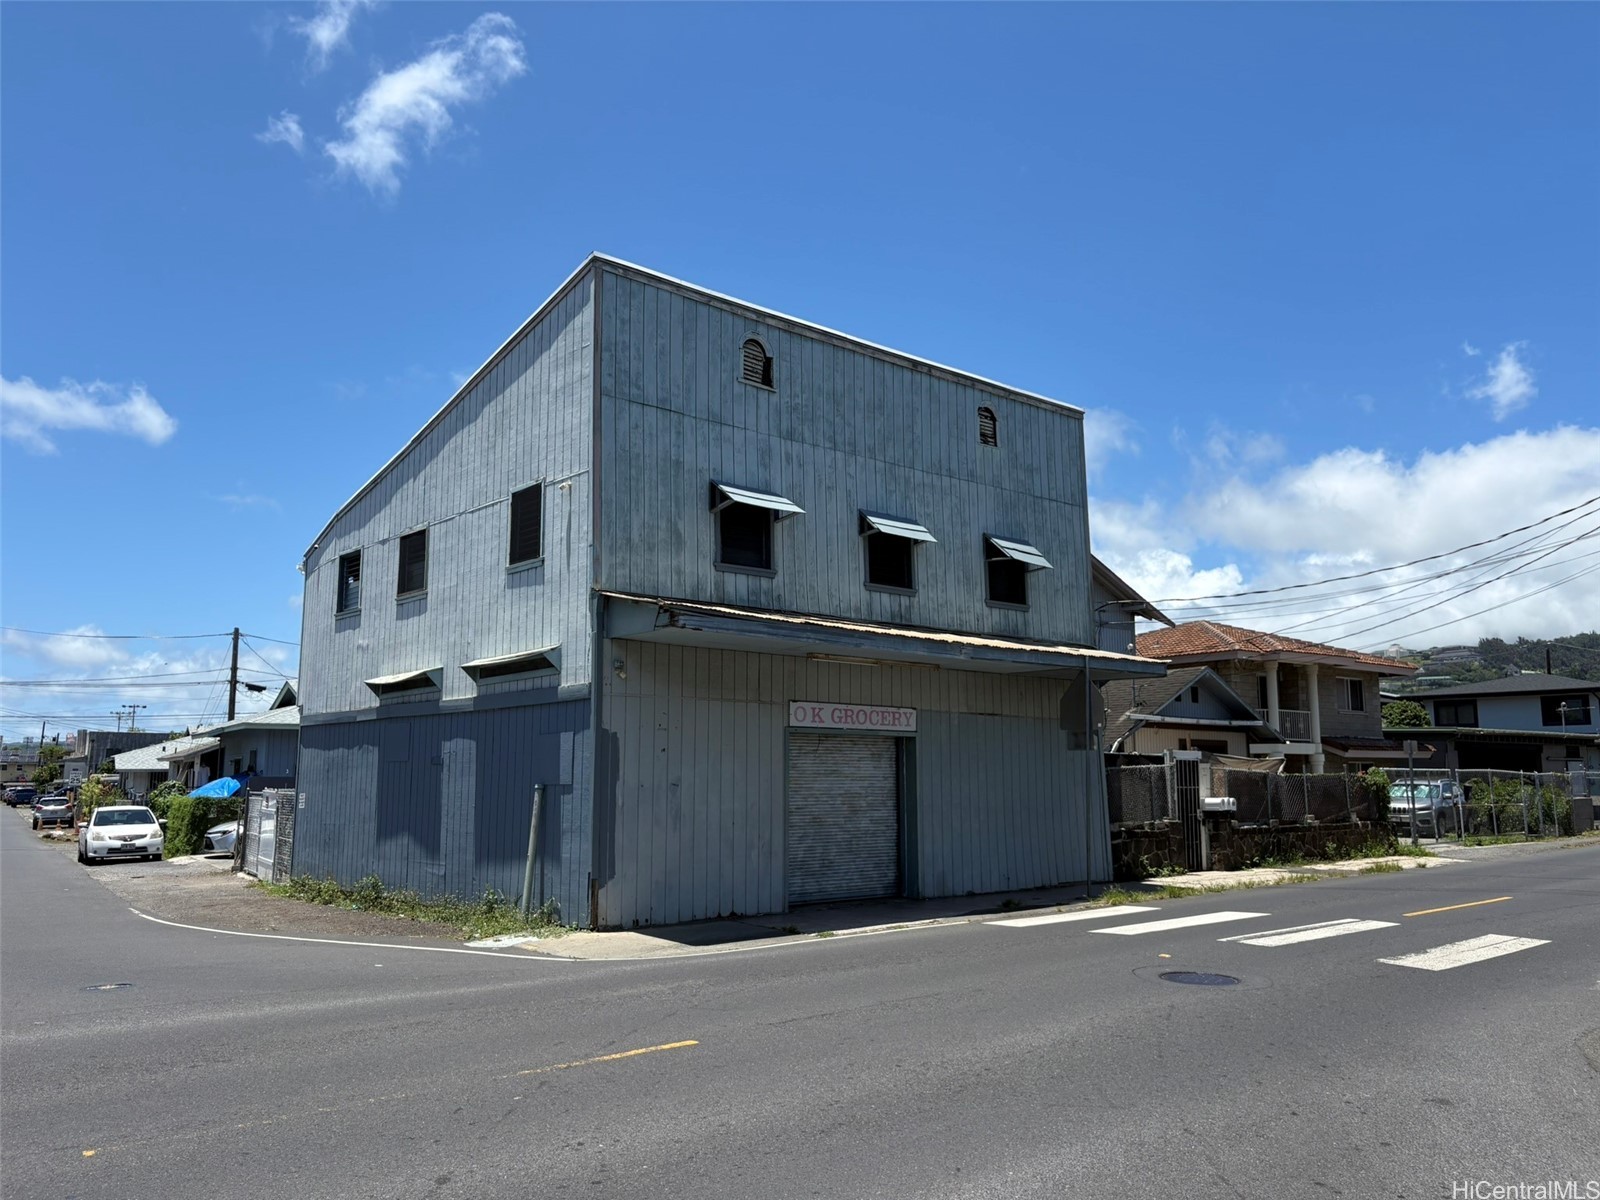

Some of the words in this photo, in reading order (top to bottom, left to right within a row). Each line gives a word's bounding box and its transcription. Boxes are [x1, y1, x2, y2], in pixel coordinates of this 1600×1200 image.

[794, 706, 807, 722] O
[811, 707, 825, 724] K
[831, 707, 914, 727] GROCERY
